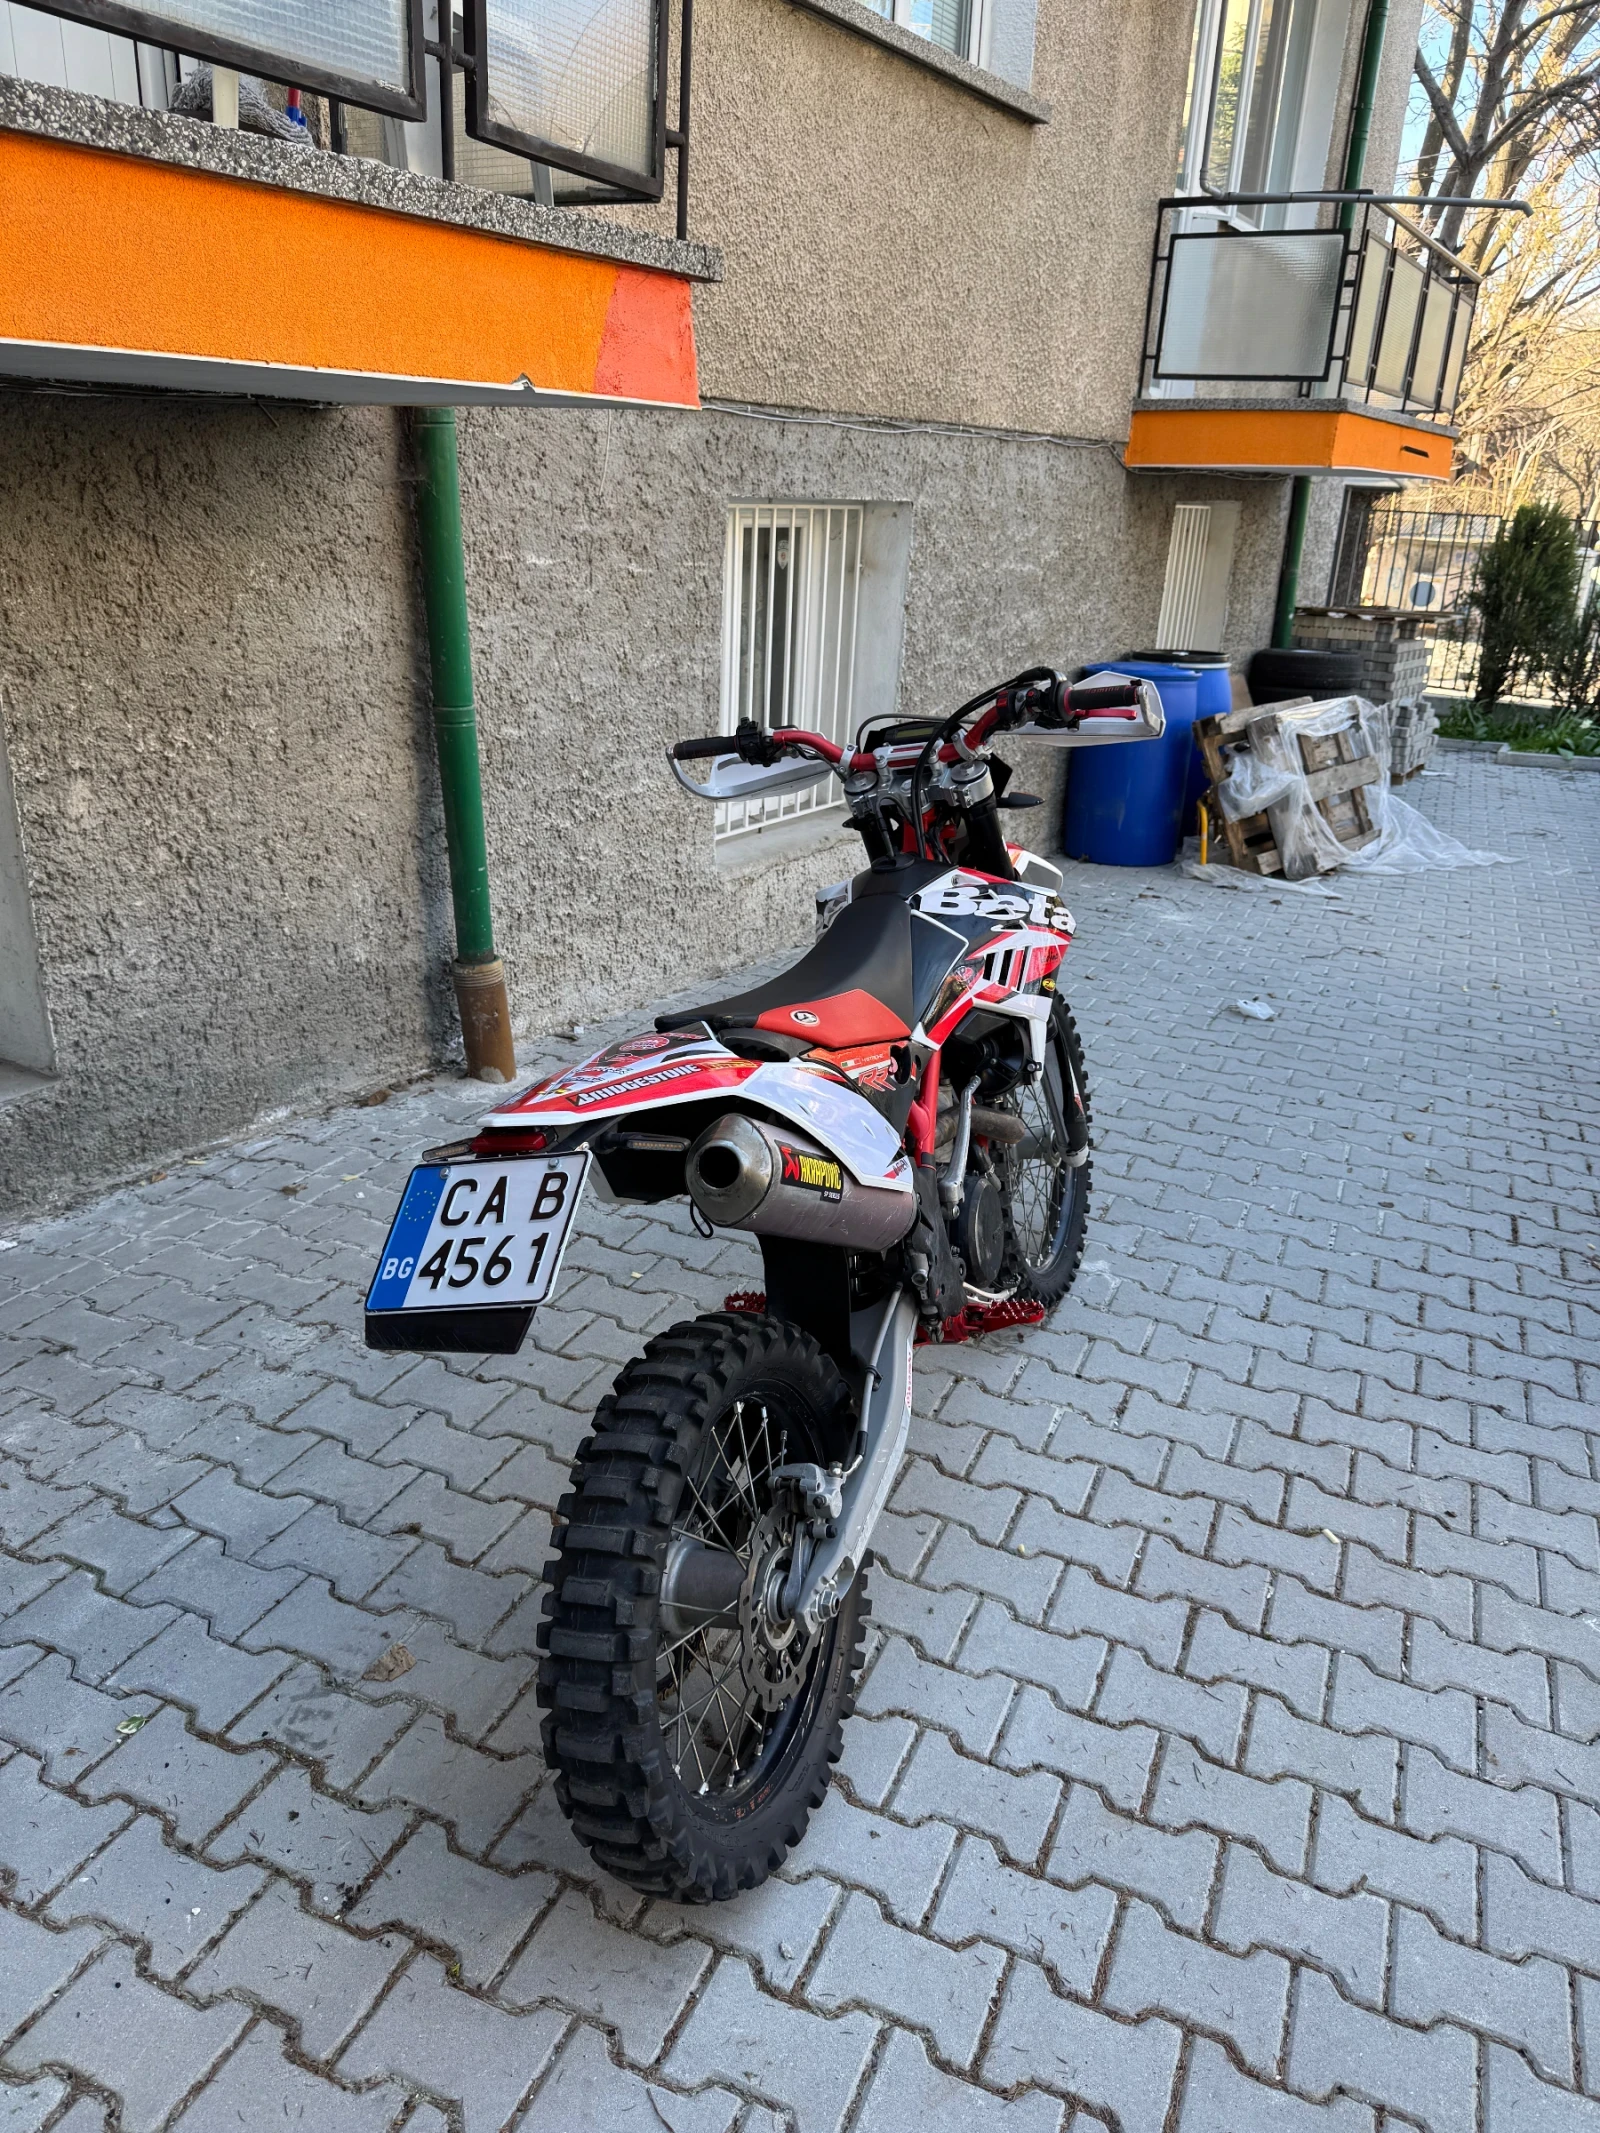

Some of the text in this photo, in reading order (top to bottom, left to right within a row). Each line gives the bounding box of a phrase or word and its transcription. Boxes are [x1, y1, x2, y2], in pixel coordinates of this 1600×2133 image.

[918, 886, 1076, 935] Beta
[567, 1063, 702, 1106] BRIDGESTONE
[858, 1066, 897, 1092] RR
[440, 1171, 569, 1228] CA B
[381, 1256, 414, 1281] BG
[418, 1232, 550, 1290] 4561
